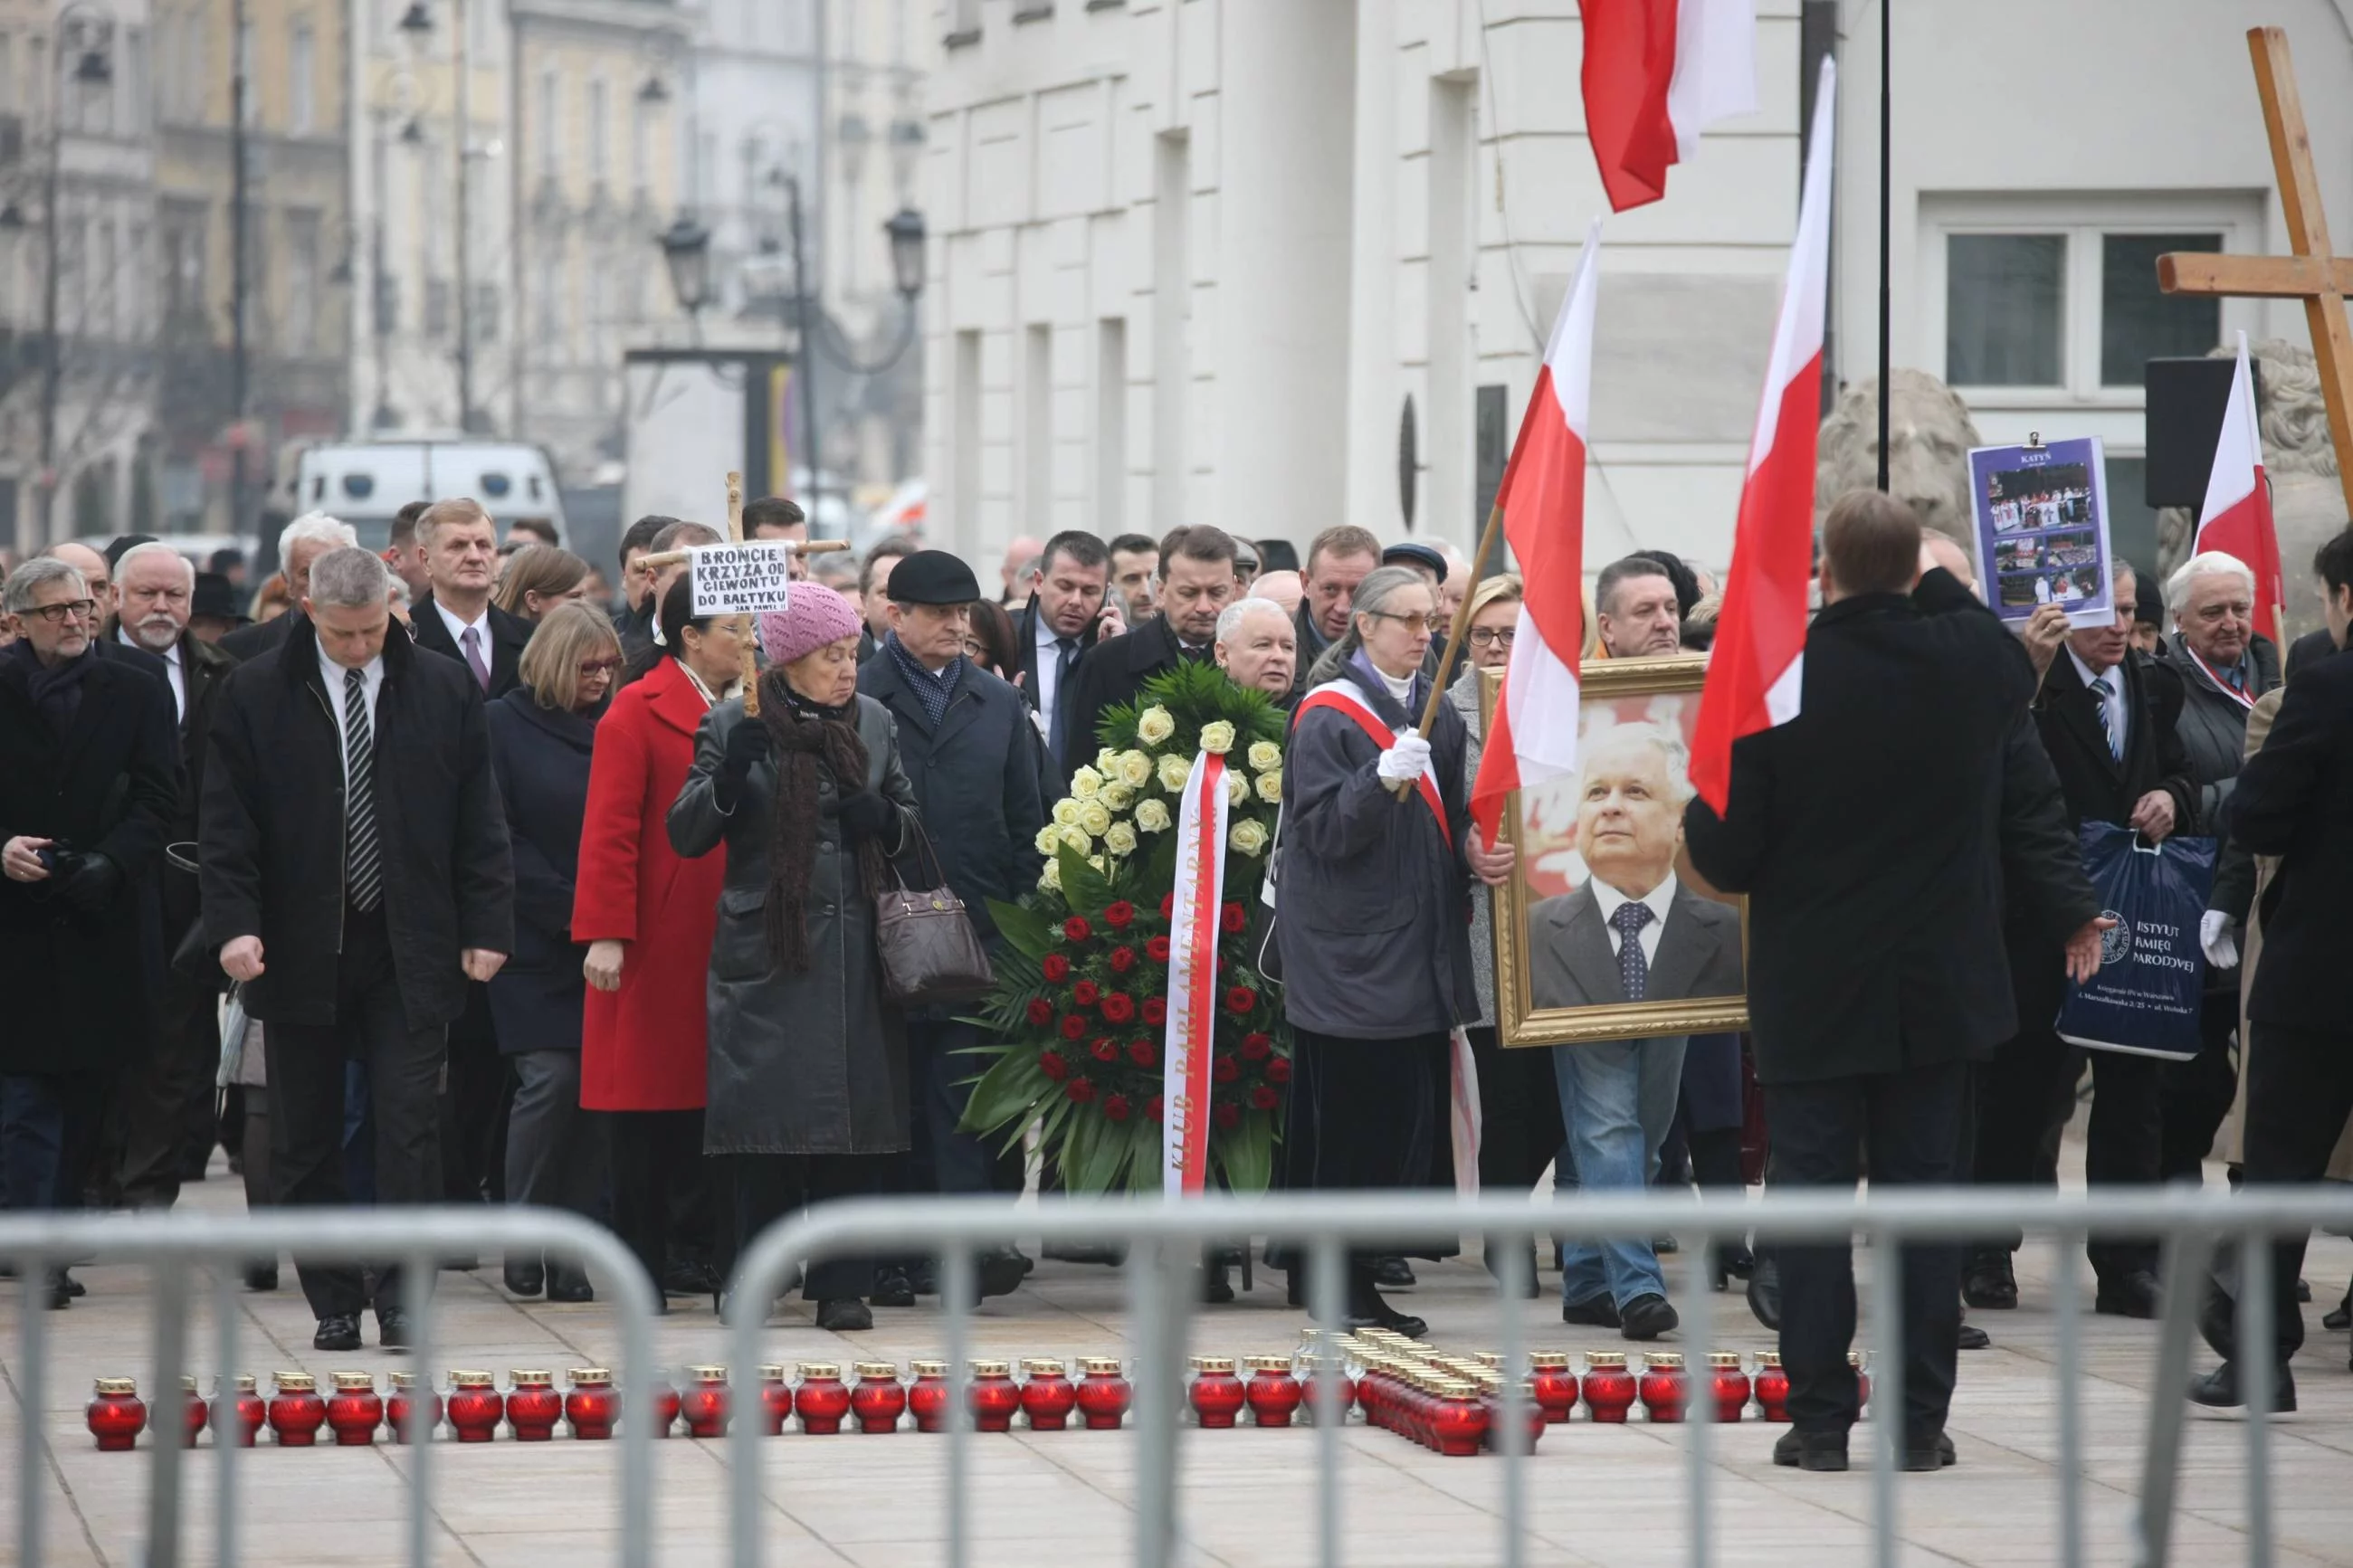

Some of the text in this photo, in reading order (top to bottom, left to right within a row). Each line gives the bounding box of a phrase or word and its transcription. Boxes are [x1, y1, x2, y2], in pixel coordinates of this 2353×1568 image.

[2020, 451, 2052, 463] KATYŃ
[768, 563, 786, 575] OD
[703, 576, 780, 592] GIEWONTU
[698, 591, 786, 606] DO BAŁTYKU
[1172, 808, 1206, 1174] KLUB PARLAMENTARNY
